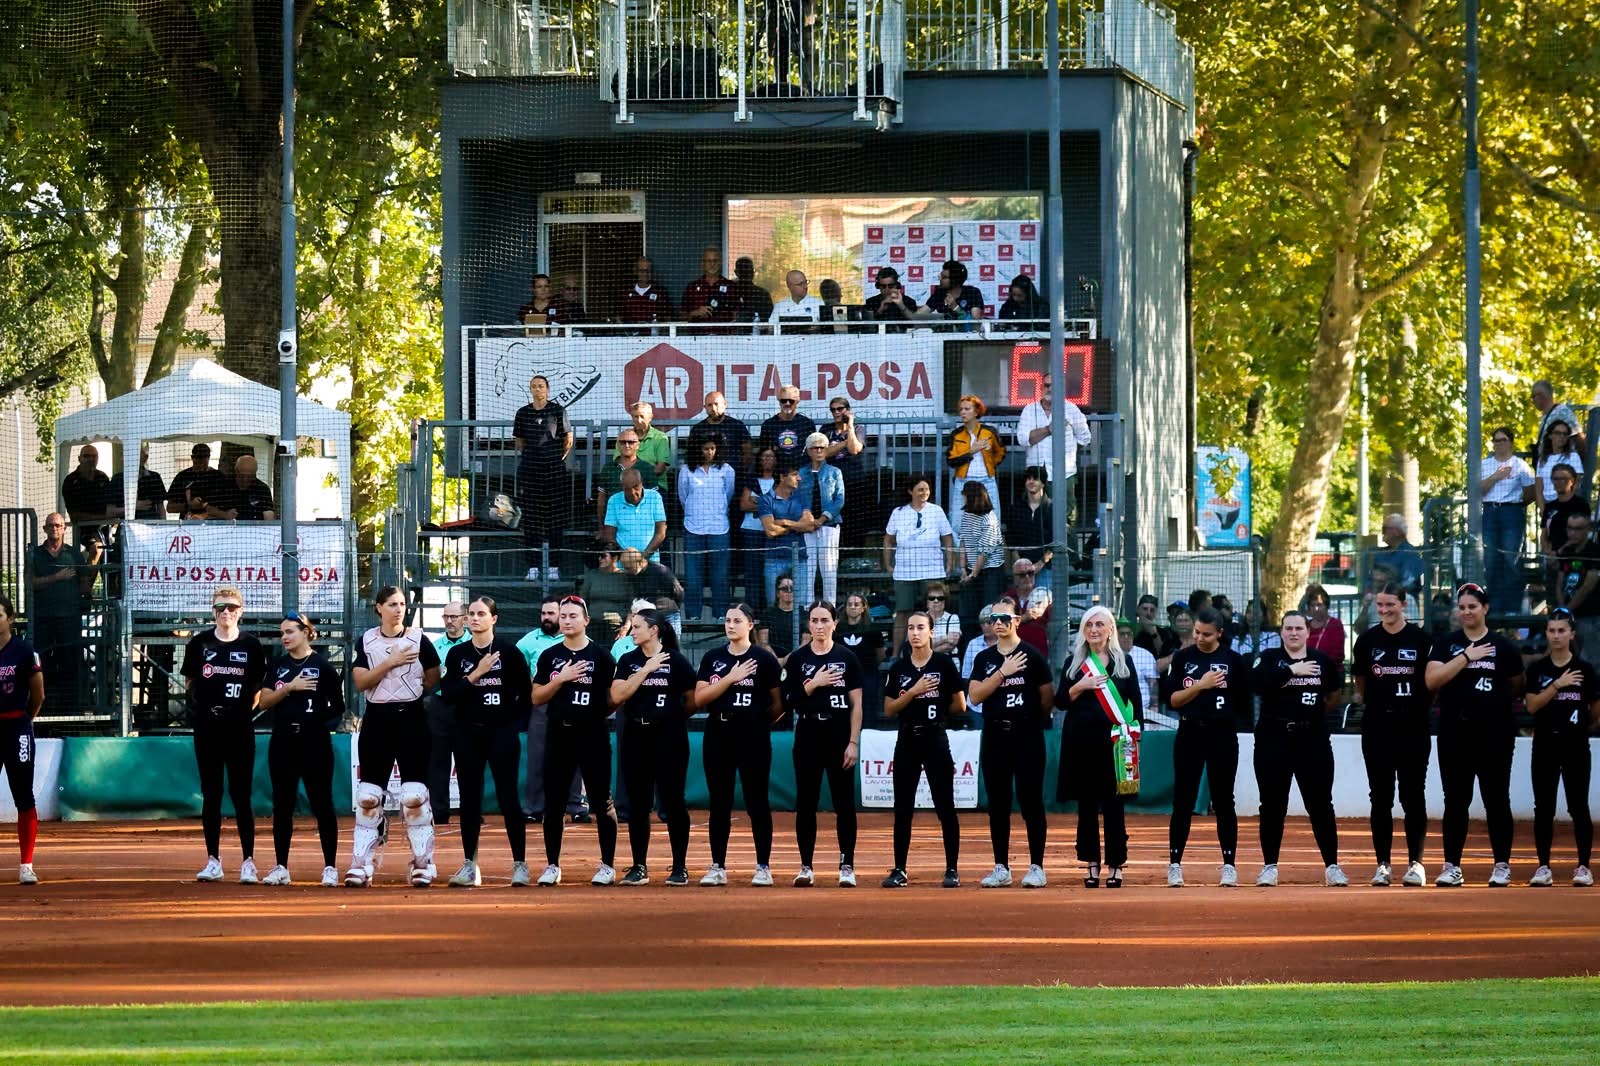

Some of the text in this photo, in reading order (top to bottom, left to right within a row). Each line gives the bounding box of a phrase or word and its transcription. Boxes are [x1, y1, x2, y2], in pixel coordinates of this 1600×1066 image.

[639, 361, 933, 409] AR ITALPOSA
[168, 535, 192, 554] AR
[129, 565, 231, 581] ITALPOSA
[236, 567, 339, 582] ITALOSA
[225, 683, 242, 698] 30
[1395, 682, 1412, 696] 11
[1475, 677, 1493, 692] 45
[305, 698, 314, 712] 1
[483, 693, 501, 705] 38
[572, 691, 590, 705] 18
[655, 694, 667, 707] 5
[733, 692, 752, 706] 15
[829, 694, 848, 708] 21
[1006, 692, 1024, 707] 24
[1216, 696, 1225, 709] 2
[927, 704, 937, 719] 6
[1569, 709, 1579, 724] 4
